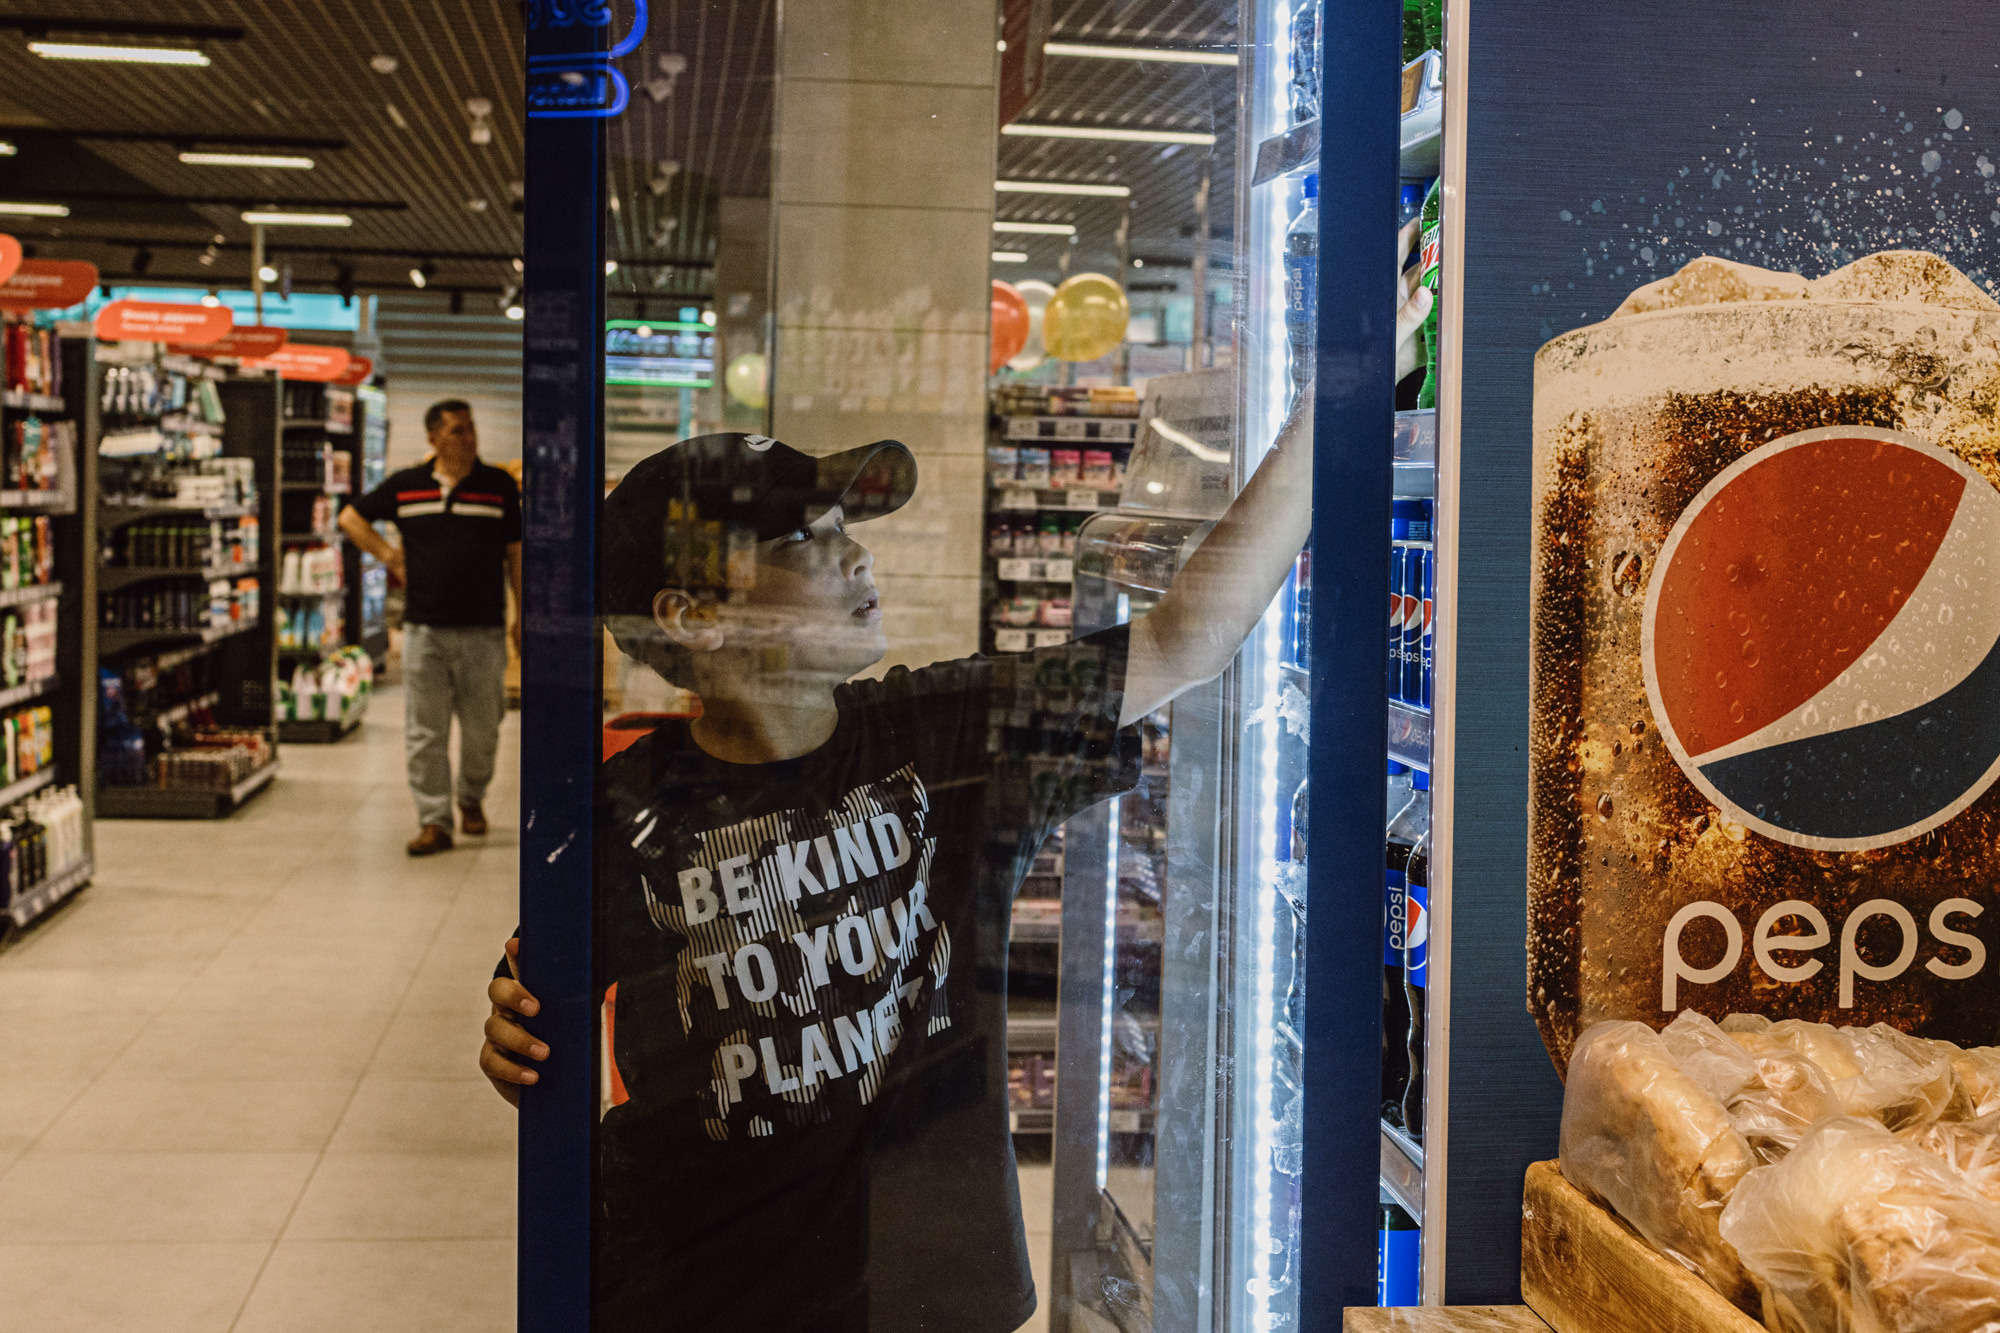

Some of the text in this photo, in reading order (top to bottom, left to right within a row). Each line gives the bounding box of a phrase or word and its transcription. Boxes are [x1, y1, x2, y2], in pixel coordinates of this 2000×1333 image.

[677, 813, 912, 926] BE KIND
[1388, 886, 1406, 951] pepsi
[694, 880, 938, 1010] TO YOUR
[1662, 898, 1987, 1012] peps
[719, 976, 924, 1103] PLANET
